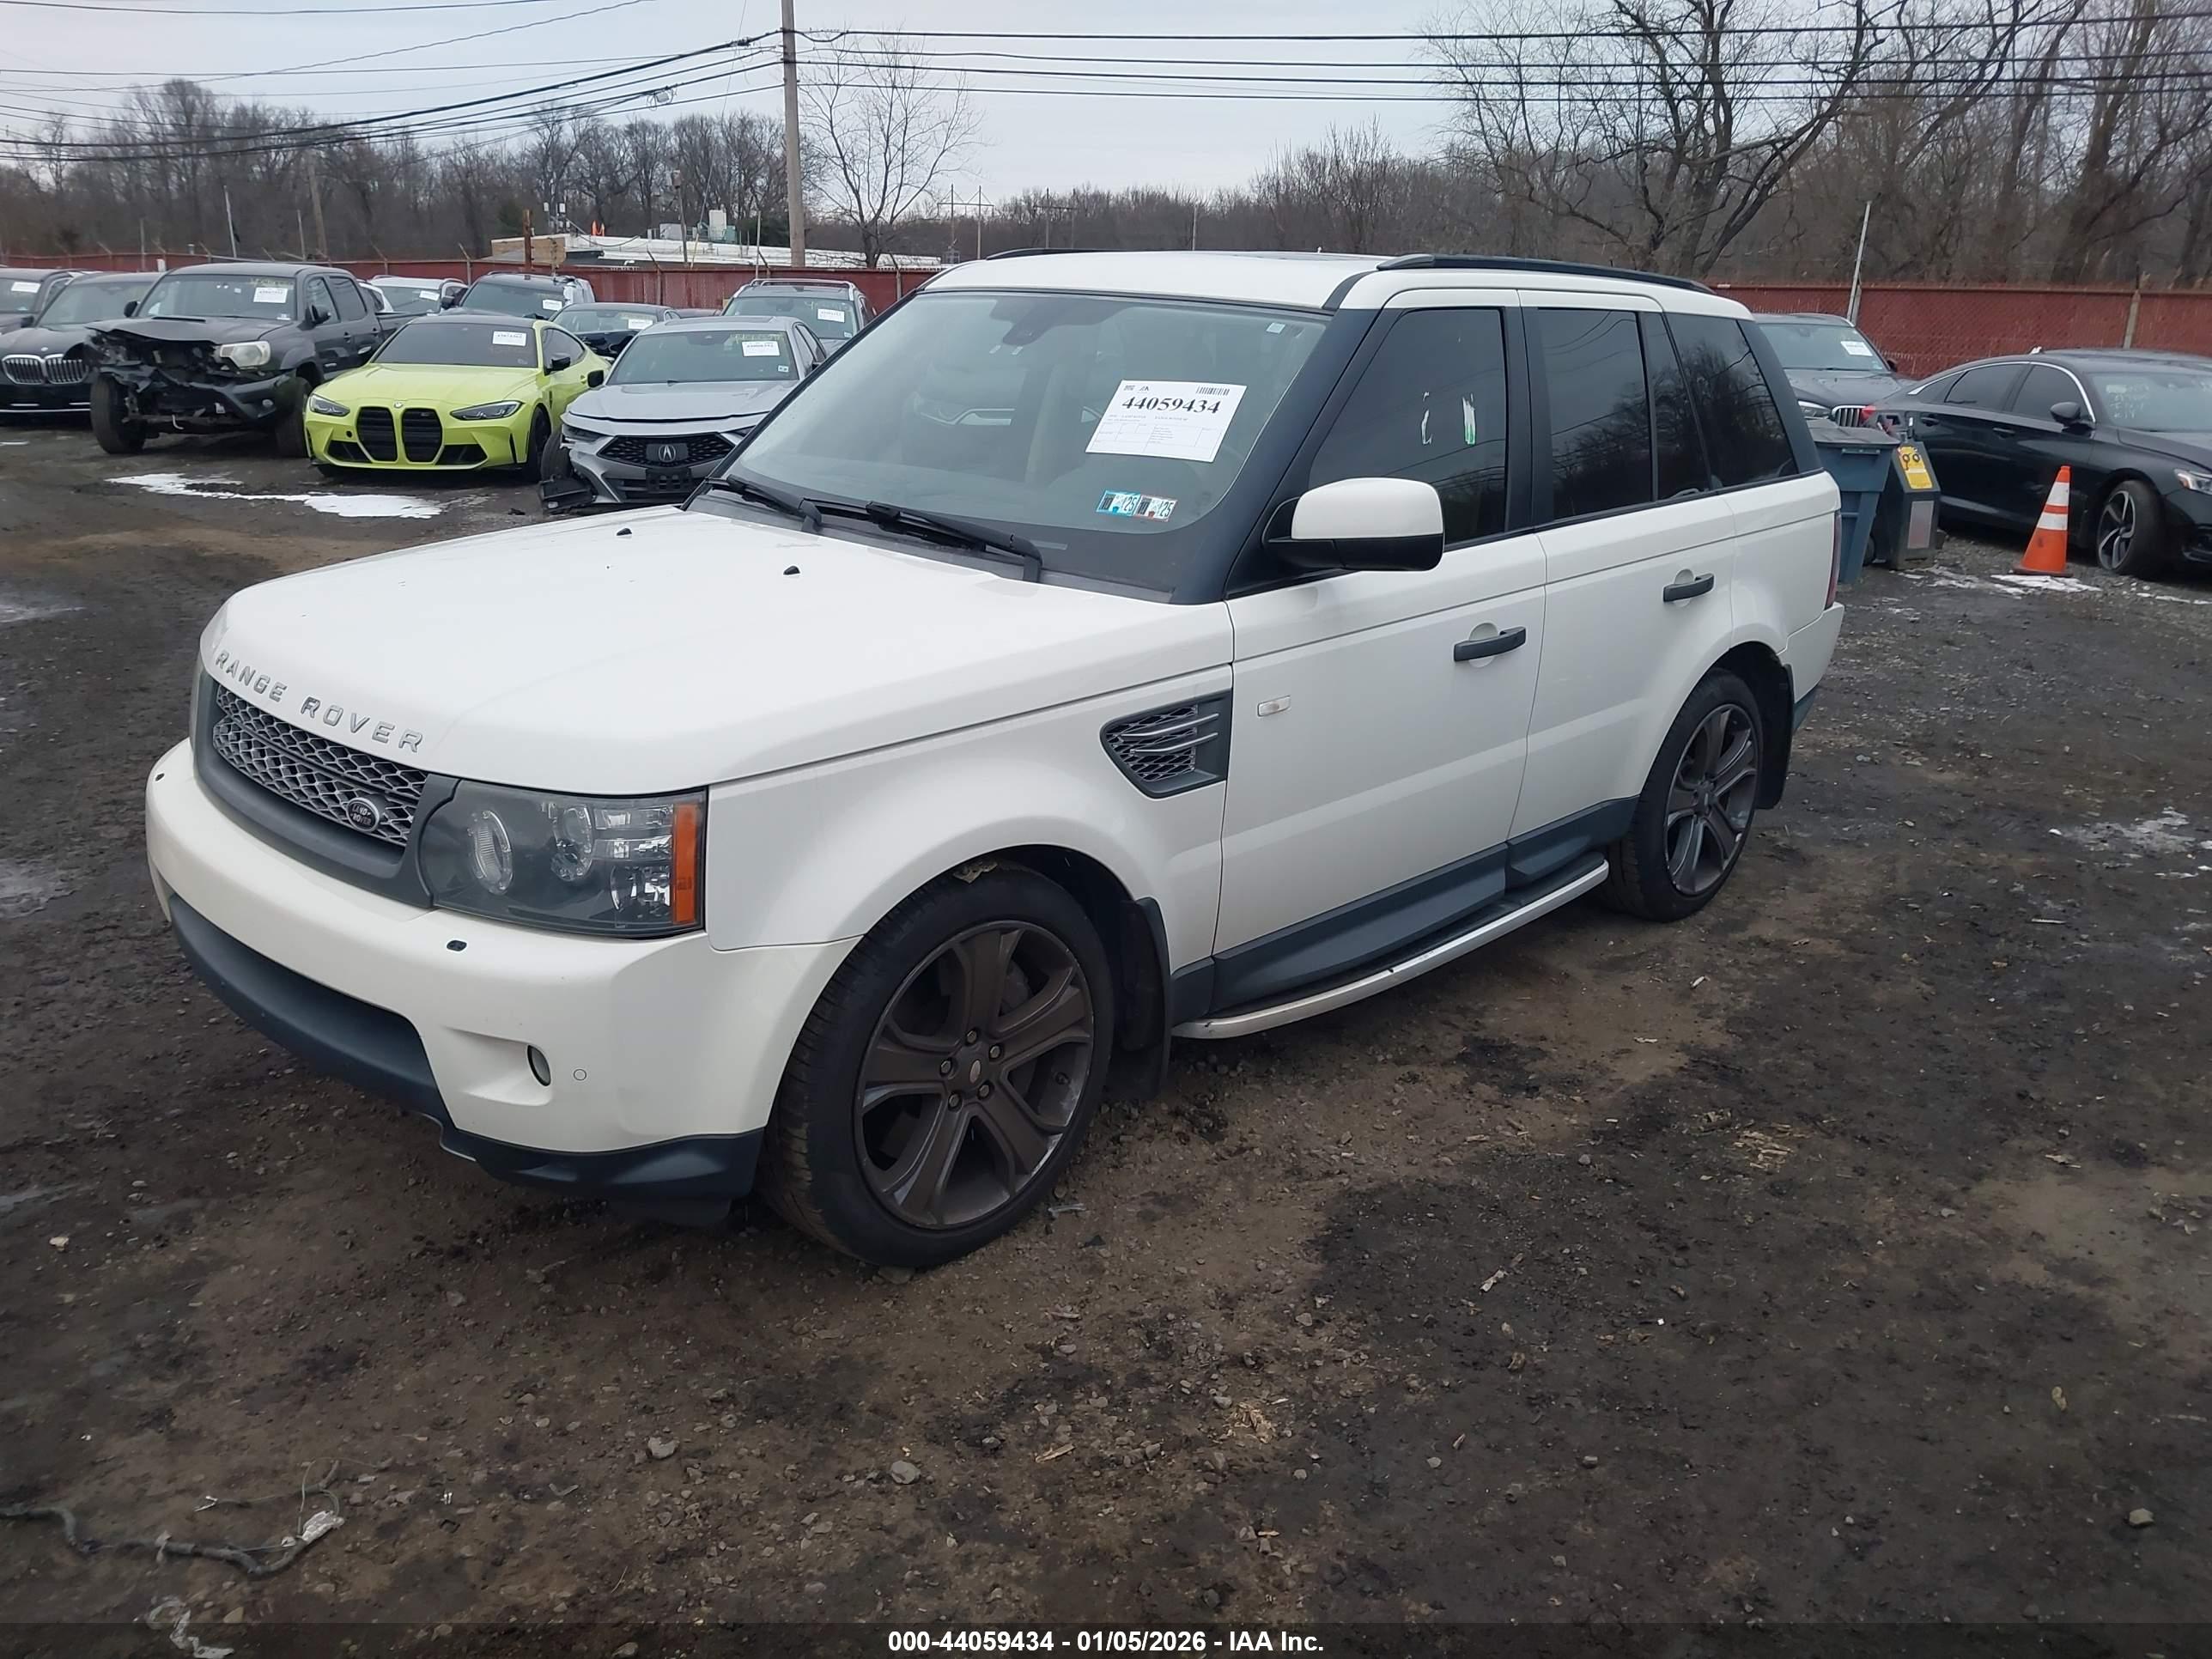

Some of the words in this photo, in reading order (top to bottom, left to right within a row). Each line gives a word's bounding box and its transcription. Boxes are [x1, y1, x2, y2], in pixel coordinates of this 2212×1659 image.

[1122, 396, 1221, 414] 44059434
[216, 650, 287, 702] RANGE
[301, 696, 422, 752] ROVER
